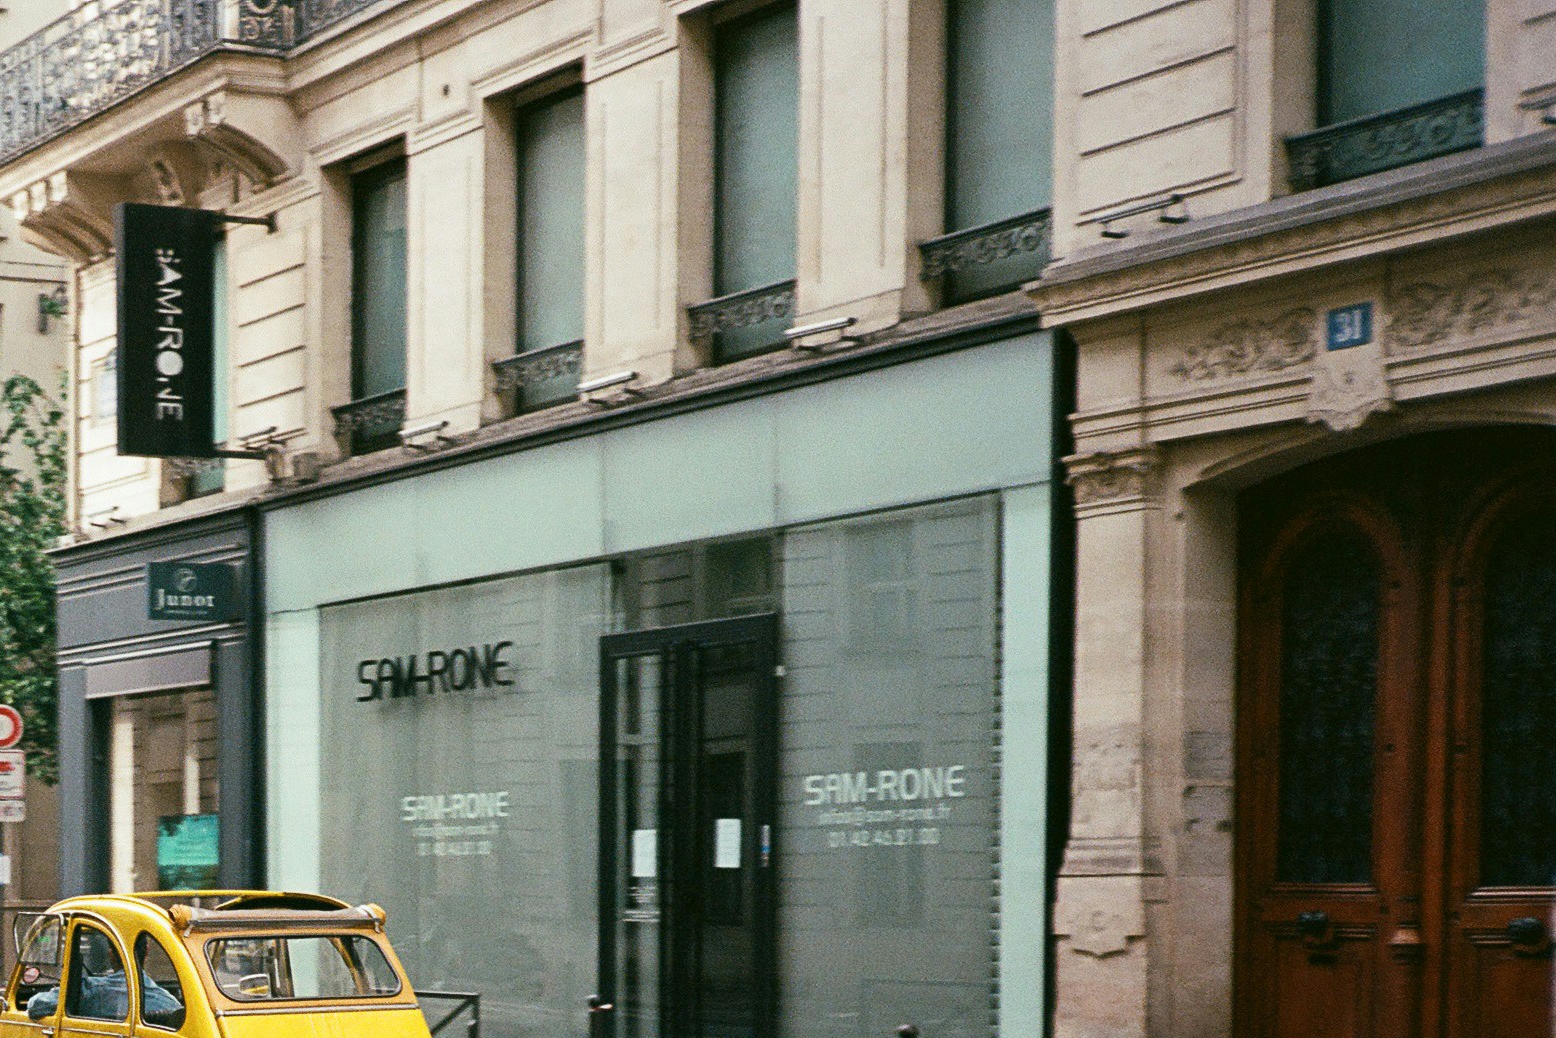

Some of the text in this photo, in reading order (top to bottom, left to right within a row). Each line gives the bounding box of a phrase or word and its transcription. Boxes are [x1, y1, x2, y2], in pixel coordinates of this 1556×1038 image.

[1335, 310, 1362, 342] 31
[356, 640, 517, 703] SAM-RONE
[803, 765, 966, 806] SAM-RONE
[401, 791, 510, 821] SAM-RONE
